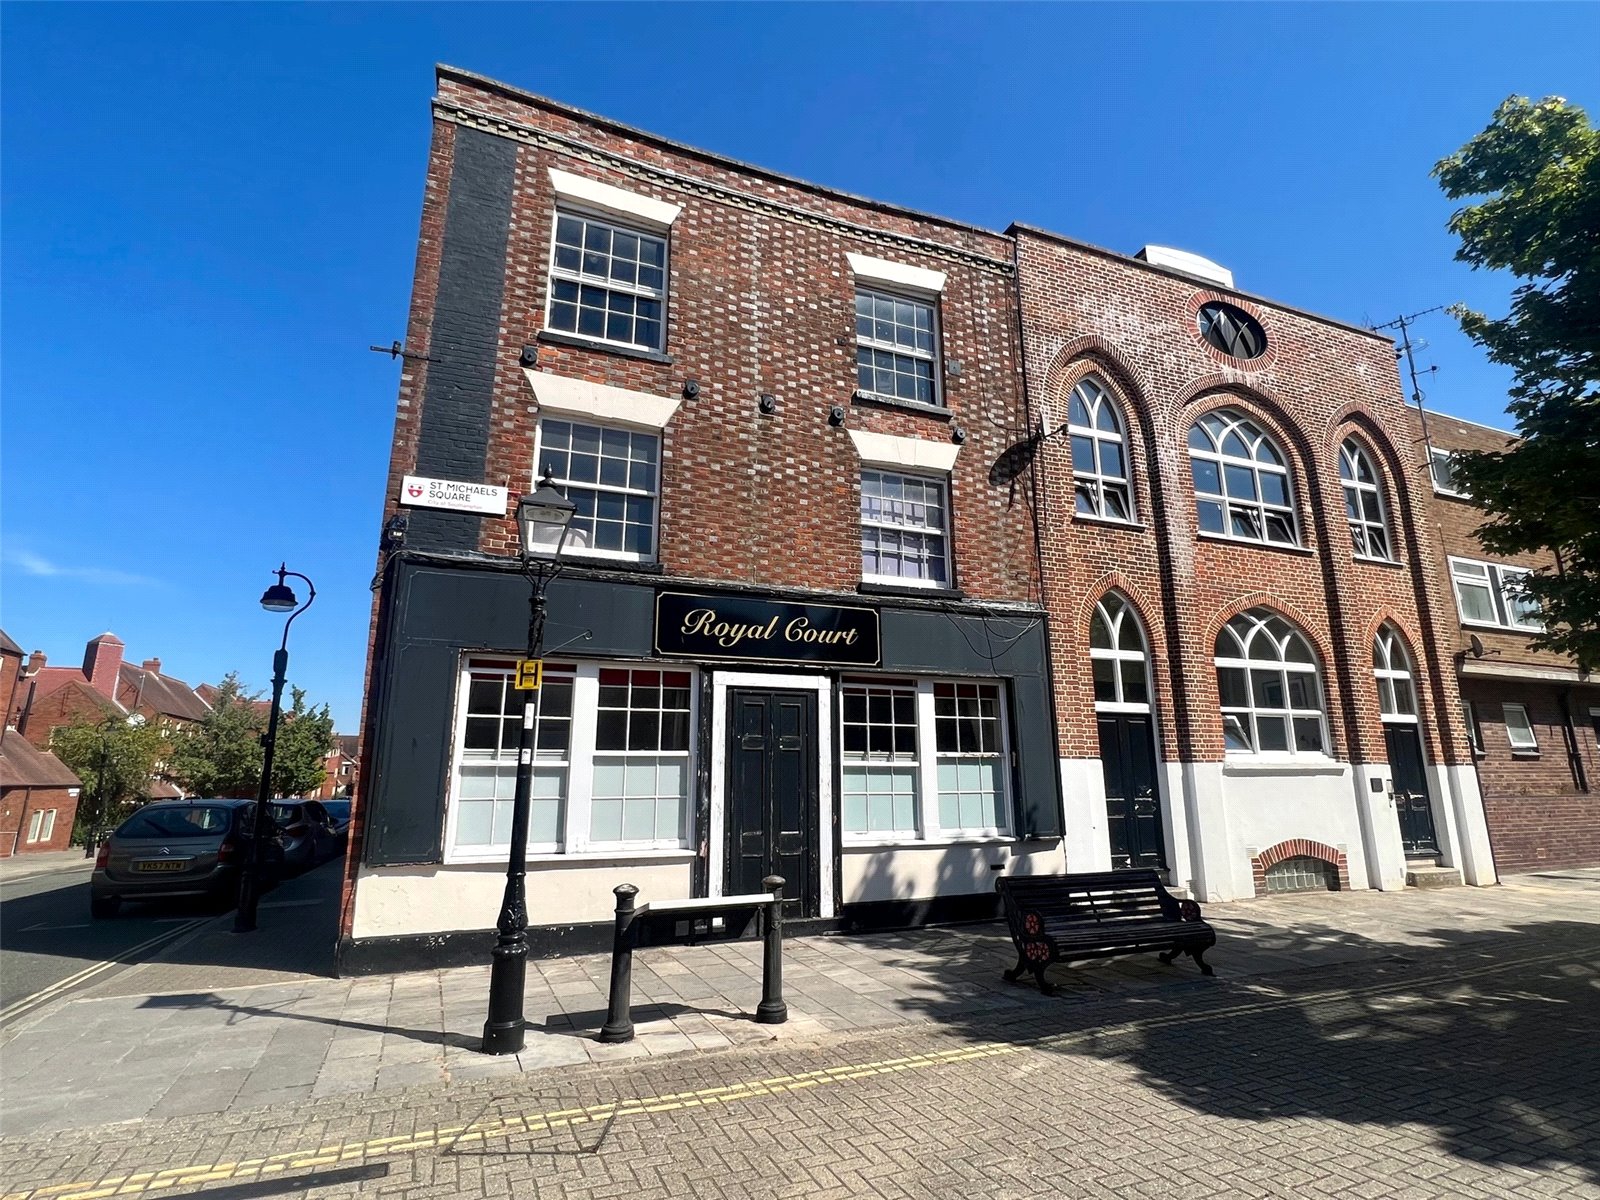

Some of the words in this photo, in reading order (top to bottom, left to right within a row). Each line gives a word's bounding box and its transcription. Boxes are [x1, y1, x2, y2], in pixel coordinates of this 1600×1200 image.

[428, 490, 471, 502] SQUARE
[430, 482, 443, 490] ST
[446, 484, 498, 496] MICHAELS
[681, 608, 780, 647] Royal
[785, 616, 859, 645] Court
[519, 662, 538, 686] H
